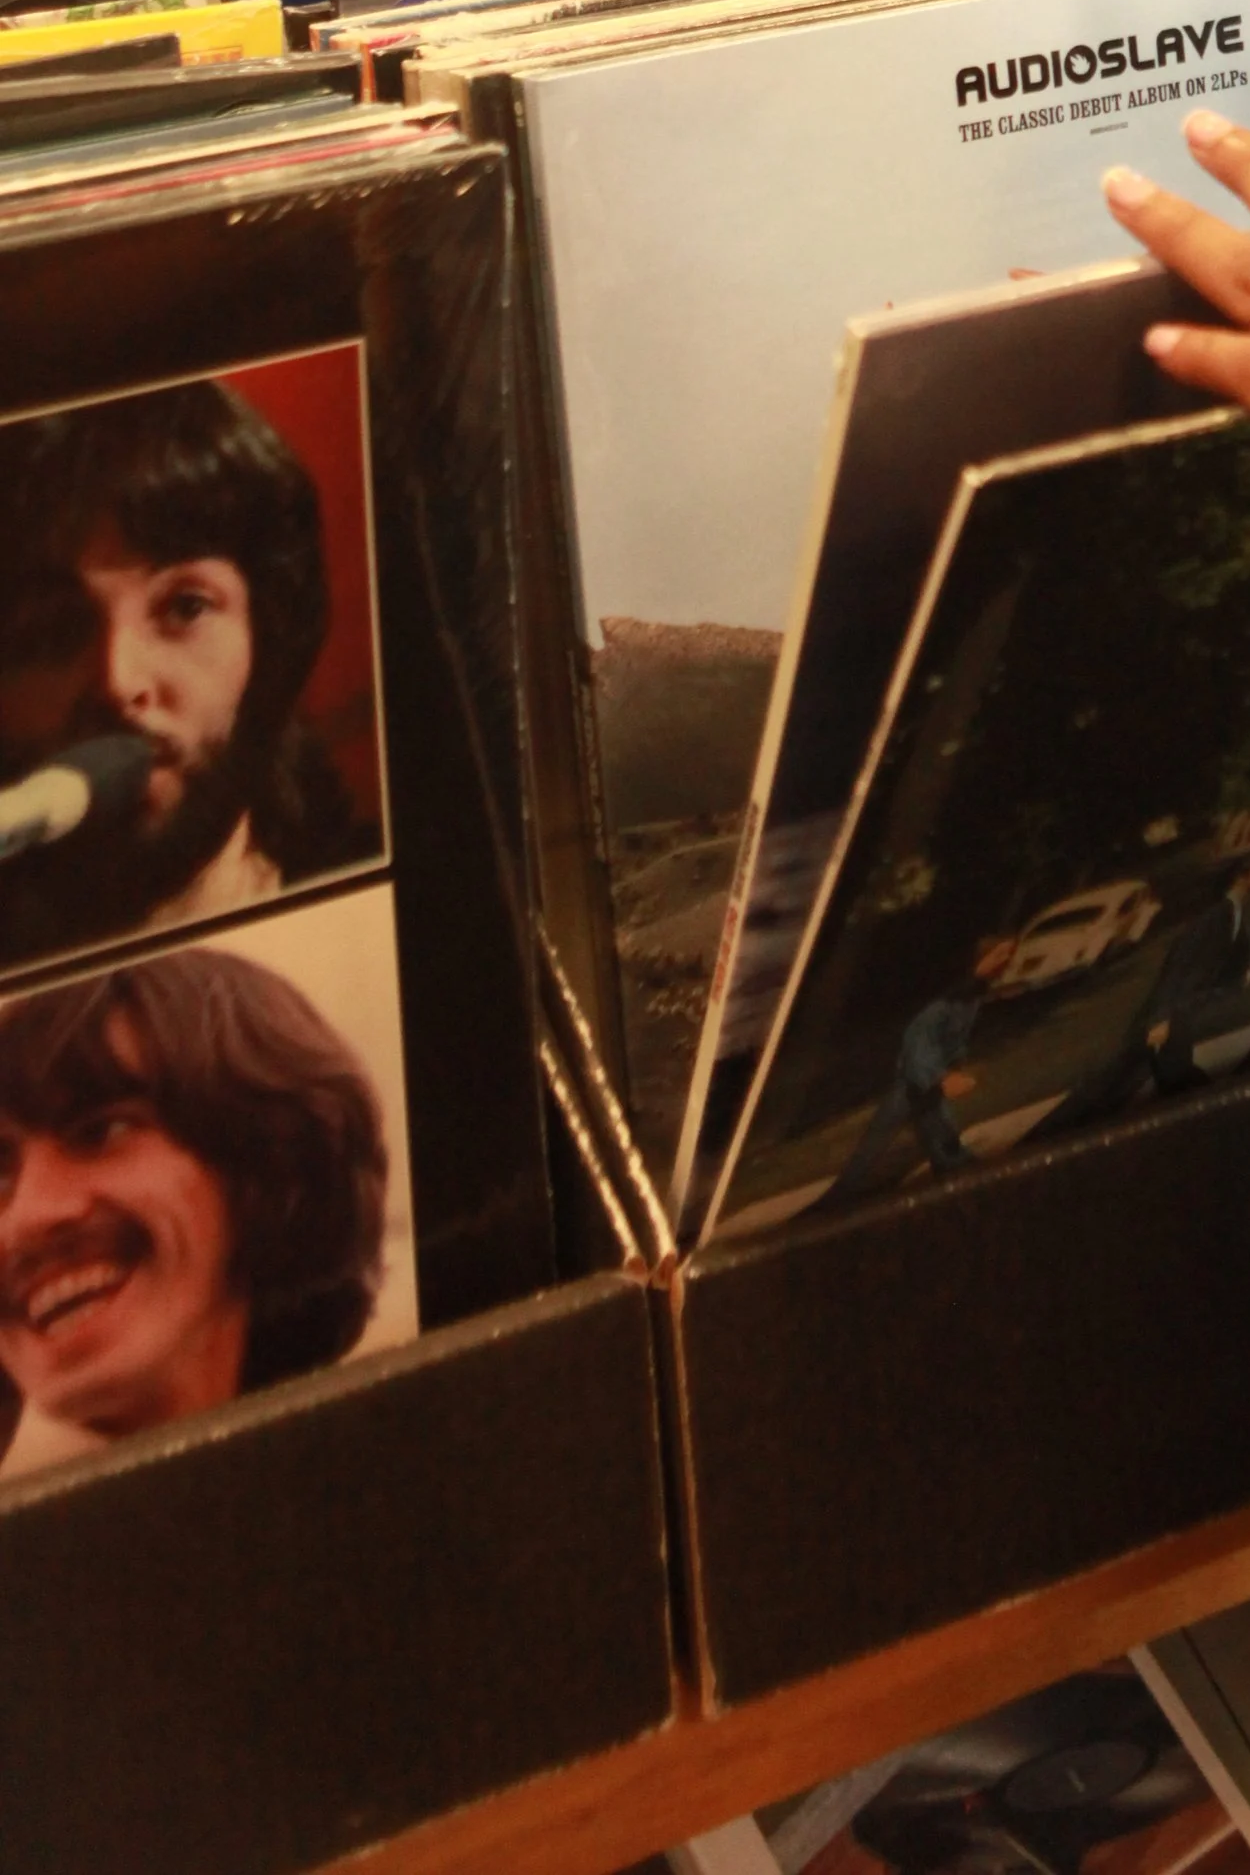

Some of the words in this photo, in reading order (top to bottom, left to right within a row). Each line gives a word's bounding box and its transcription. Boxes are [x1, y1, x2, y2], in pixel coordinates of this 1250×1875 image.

[955, 15, 1244, 108] AUDIOSLAVE
[959, 119, 993, 143] THE
[997, 105, 1065, 135] CLASSIC
[1070, 93, 1122, 122] DEBUT
[1127, 82, 1182, 109] ALBUM
[1186, 77, 1207, 98] ON
[1211, 69, 1249, 92] 2LPs
